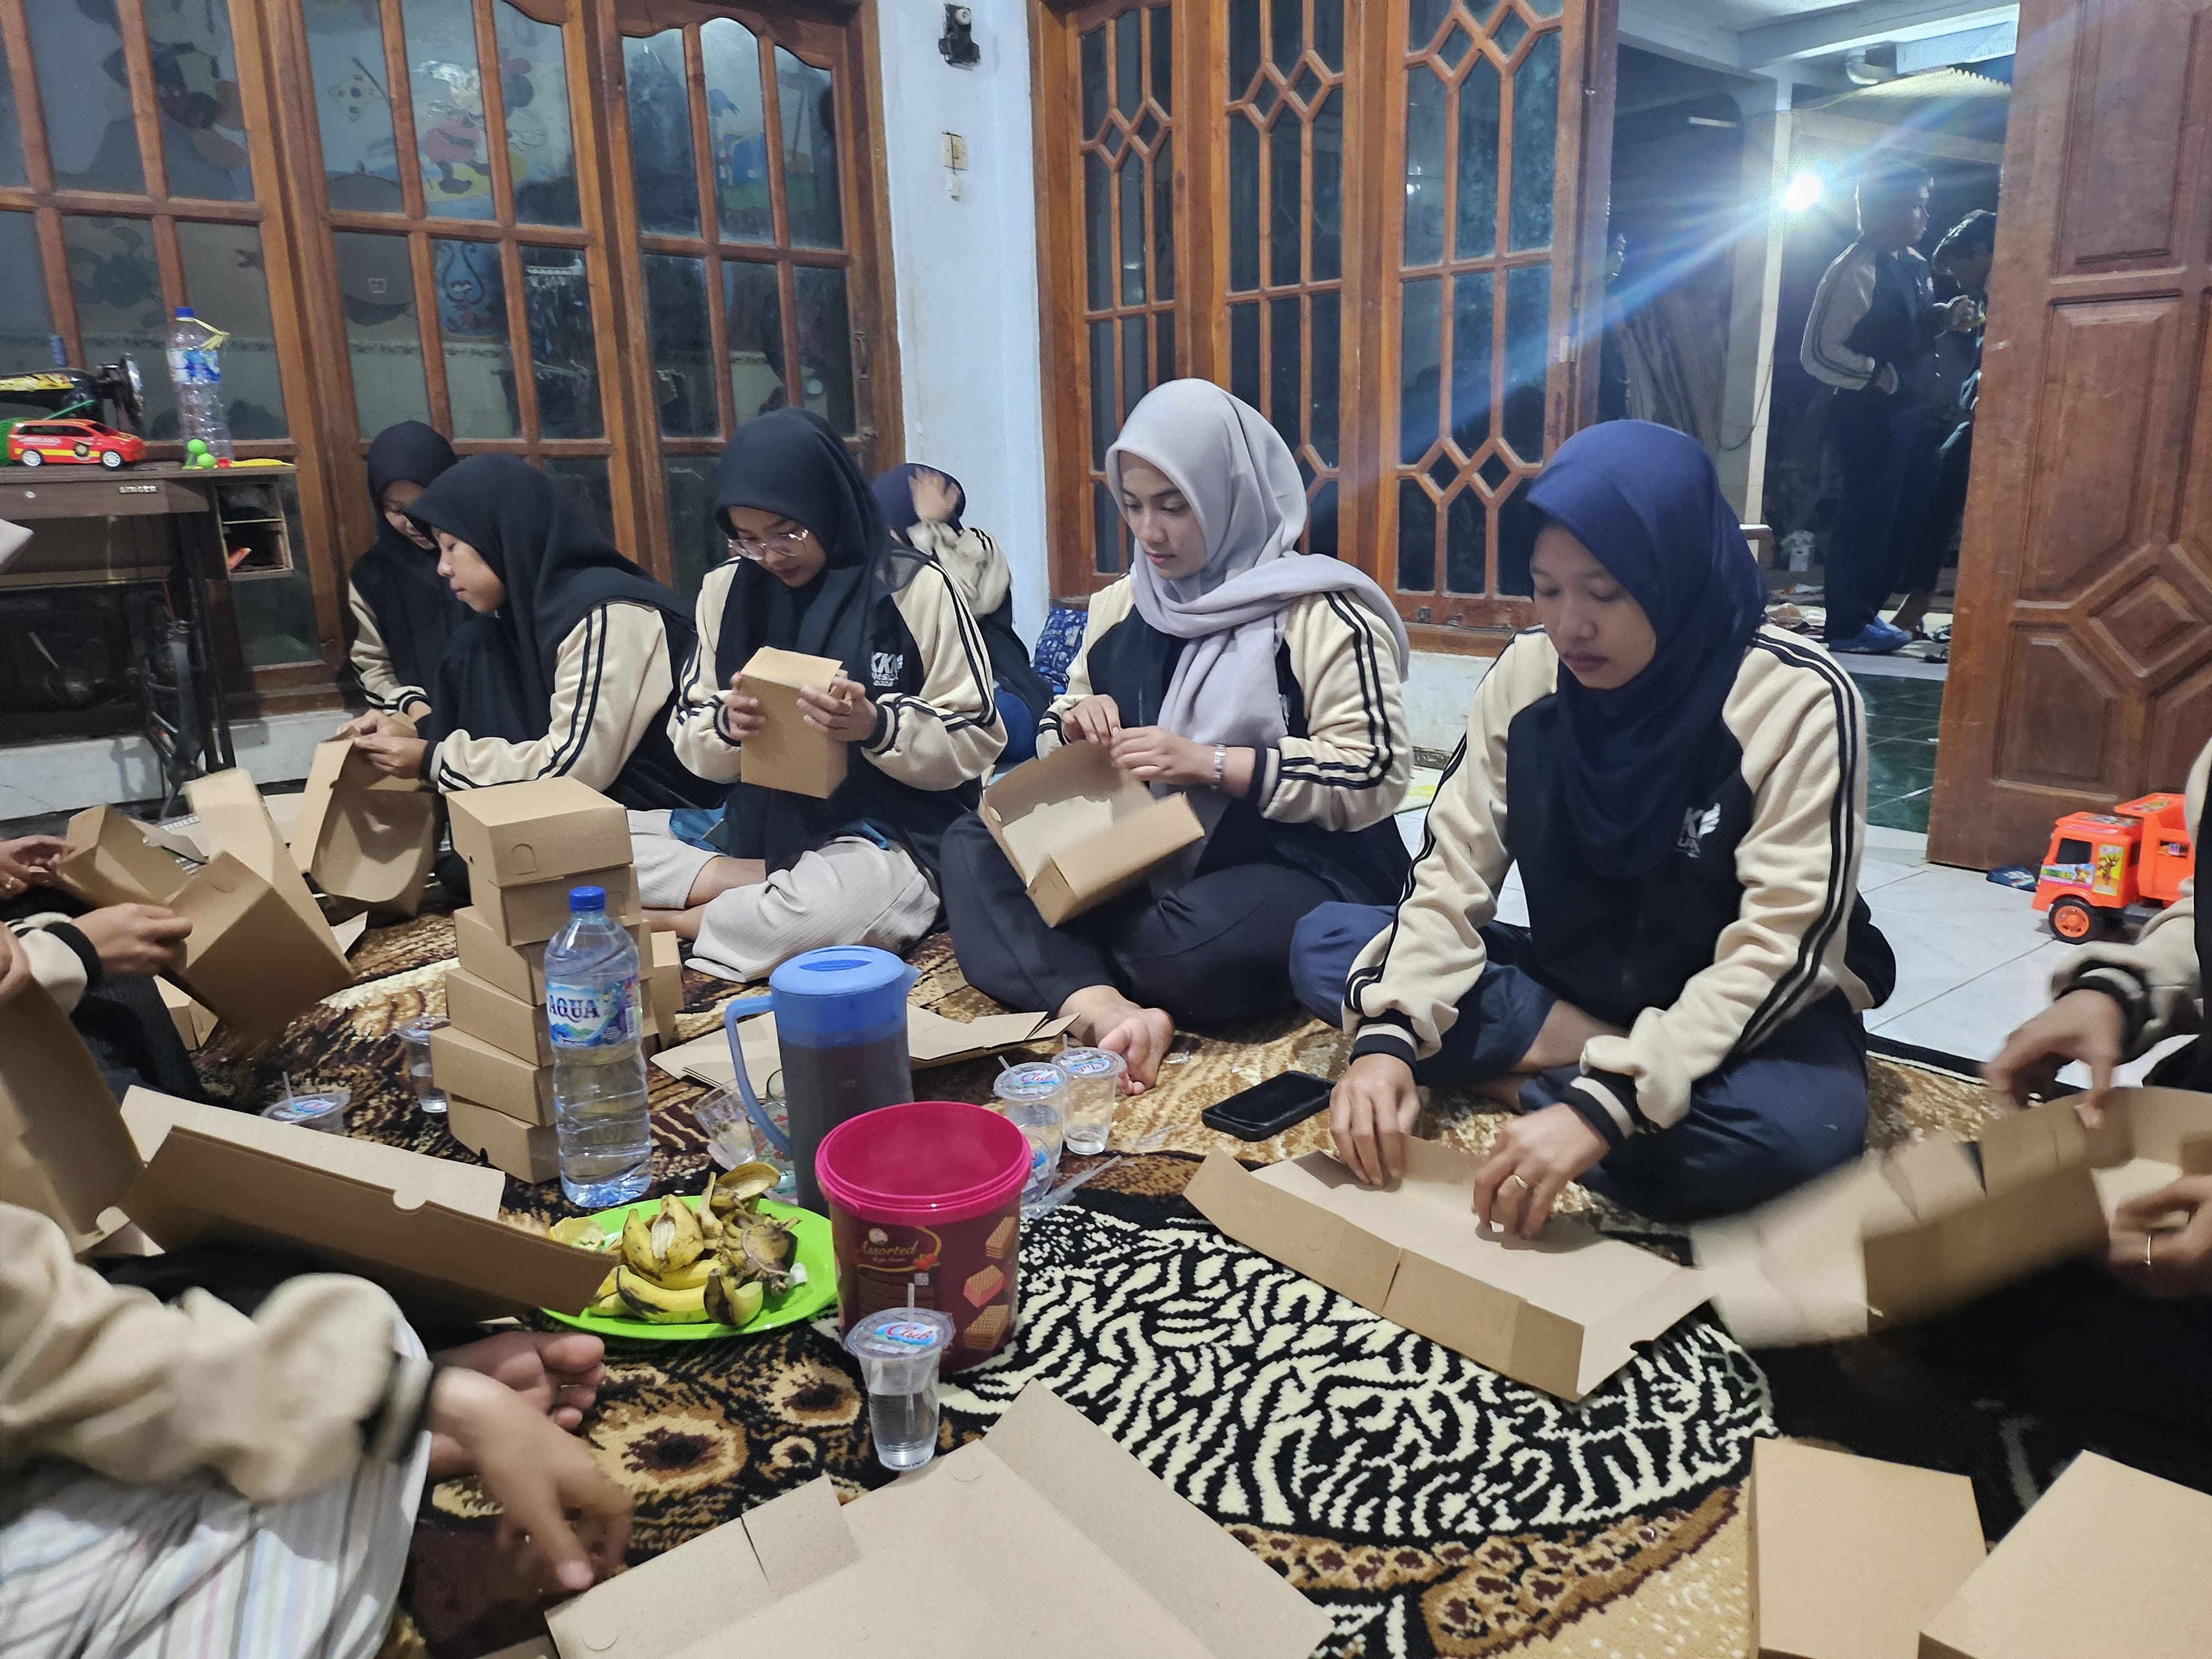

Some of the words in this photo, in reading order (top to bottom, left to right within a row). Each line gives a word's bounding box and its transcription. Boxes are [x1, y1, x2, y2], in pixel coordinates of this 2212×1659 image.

[549, 995, 601, 1023] AQUA
[1076, 1062, 1105, 1072] Club
[1021, 1073, 1054, 1083] Club
[857, 1240, 919, 1256] Assorted
[886, 1324, 933, 1340] Club
